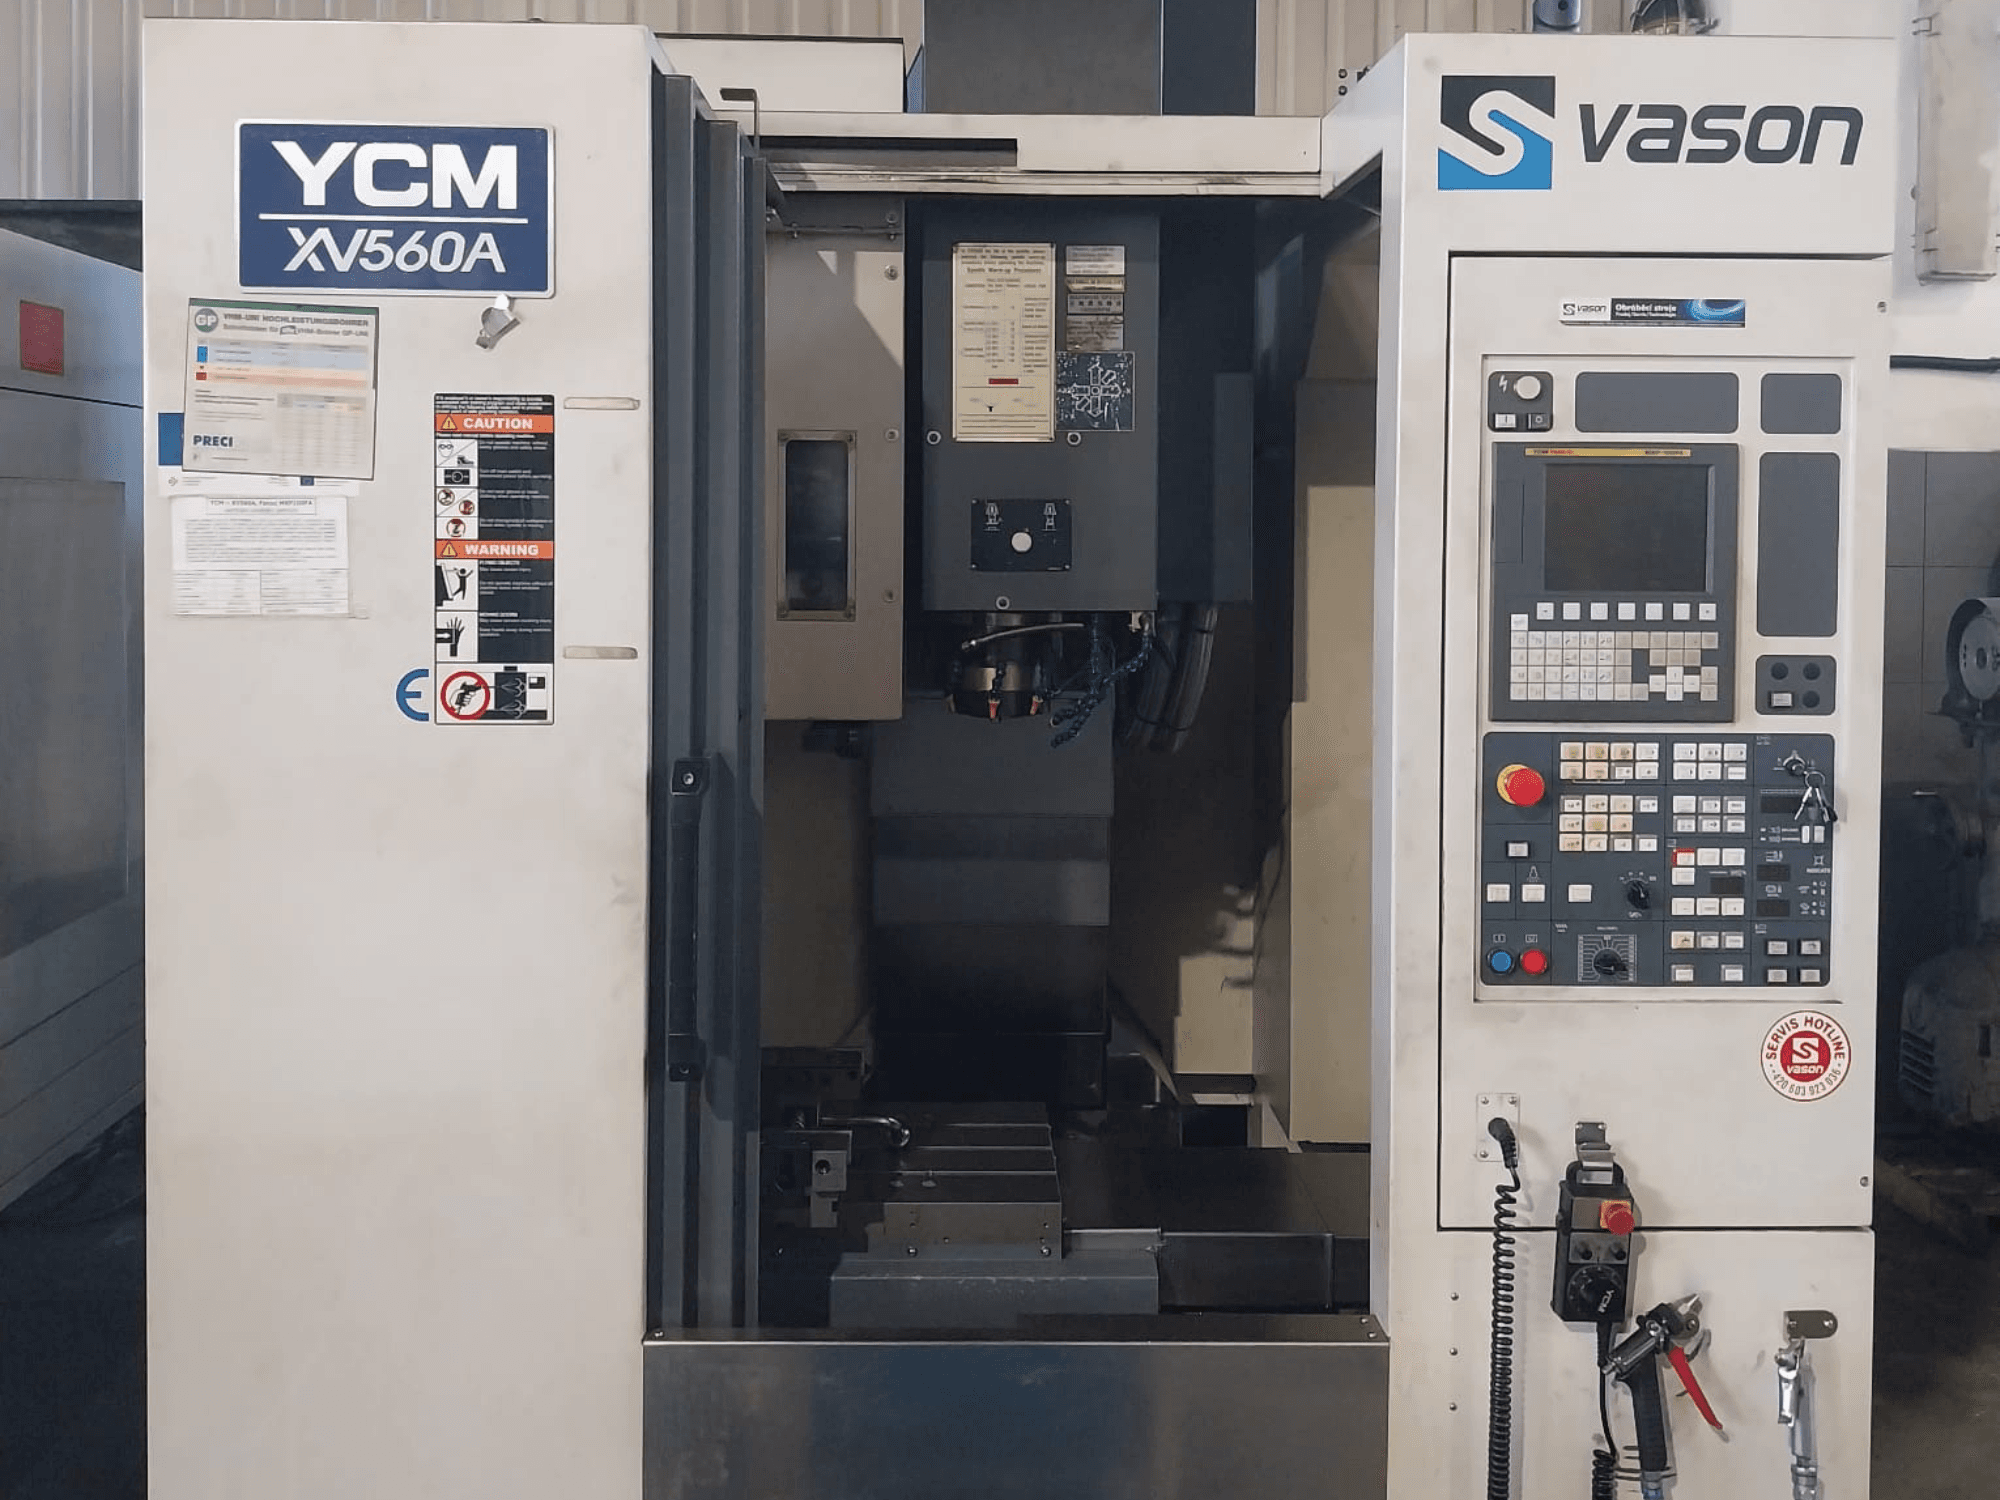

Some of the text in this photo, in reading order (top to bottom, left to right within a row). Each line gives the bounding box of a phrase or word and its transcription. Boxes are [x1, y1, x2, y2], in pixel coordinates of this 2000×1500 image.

[1578, 103, 1863, 165] vason
[271, 140, 518, 210] YCM
[282, 226, 507, 273] XV560A
[1577, 305, 1607, 313] vason
[463, 417, 533, 429] CAUTION
[193, 434, 234, 448] PRECI
[465, 544, 539, 556] WARNING
[1766, 1016, 1845, 1060] SERVIS HOTLINE
[1786, 1064, 1825, 1074] vason
